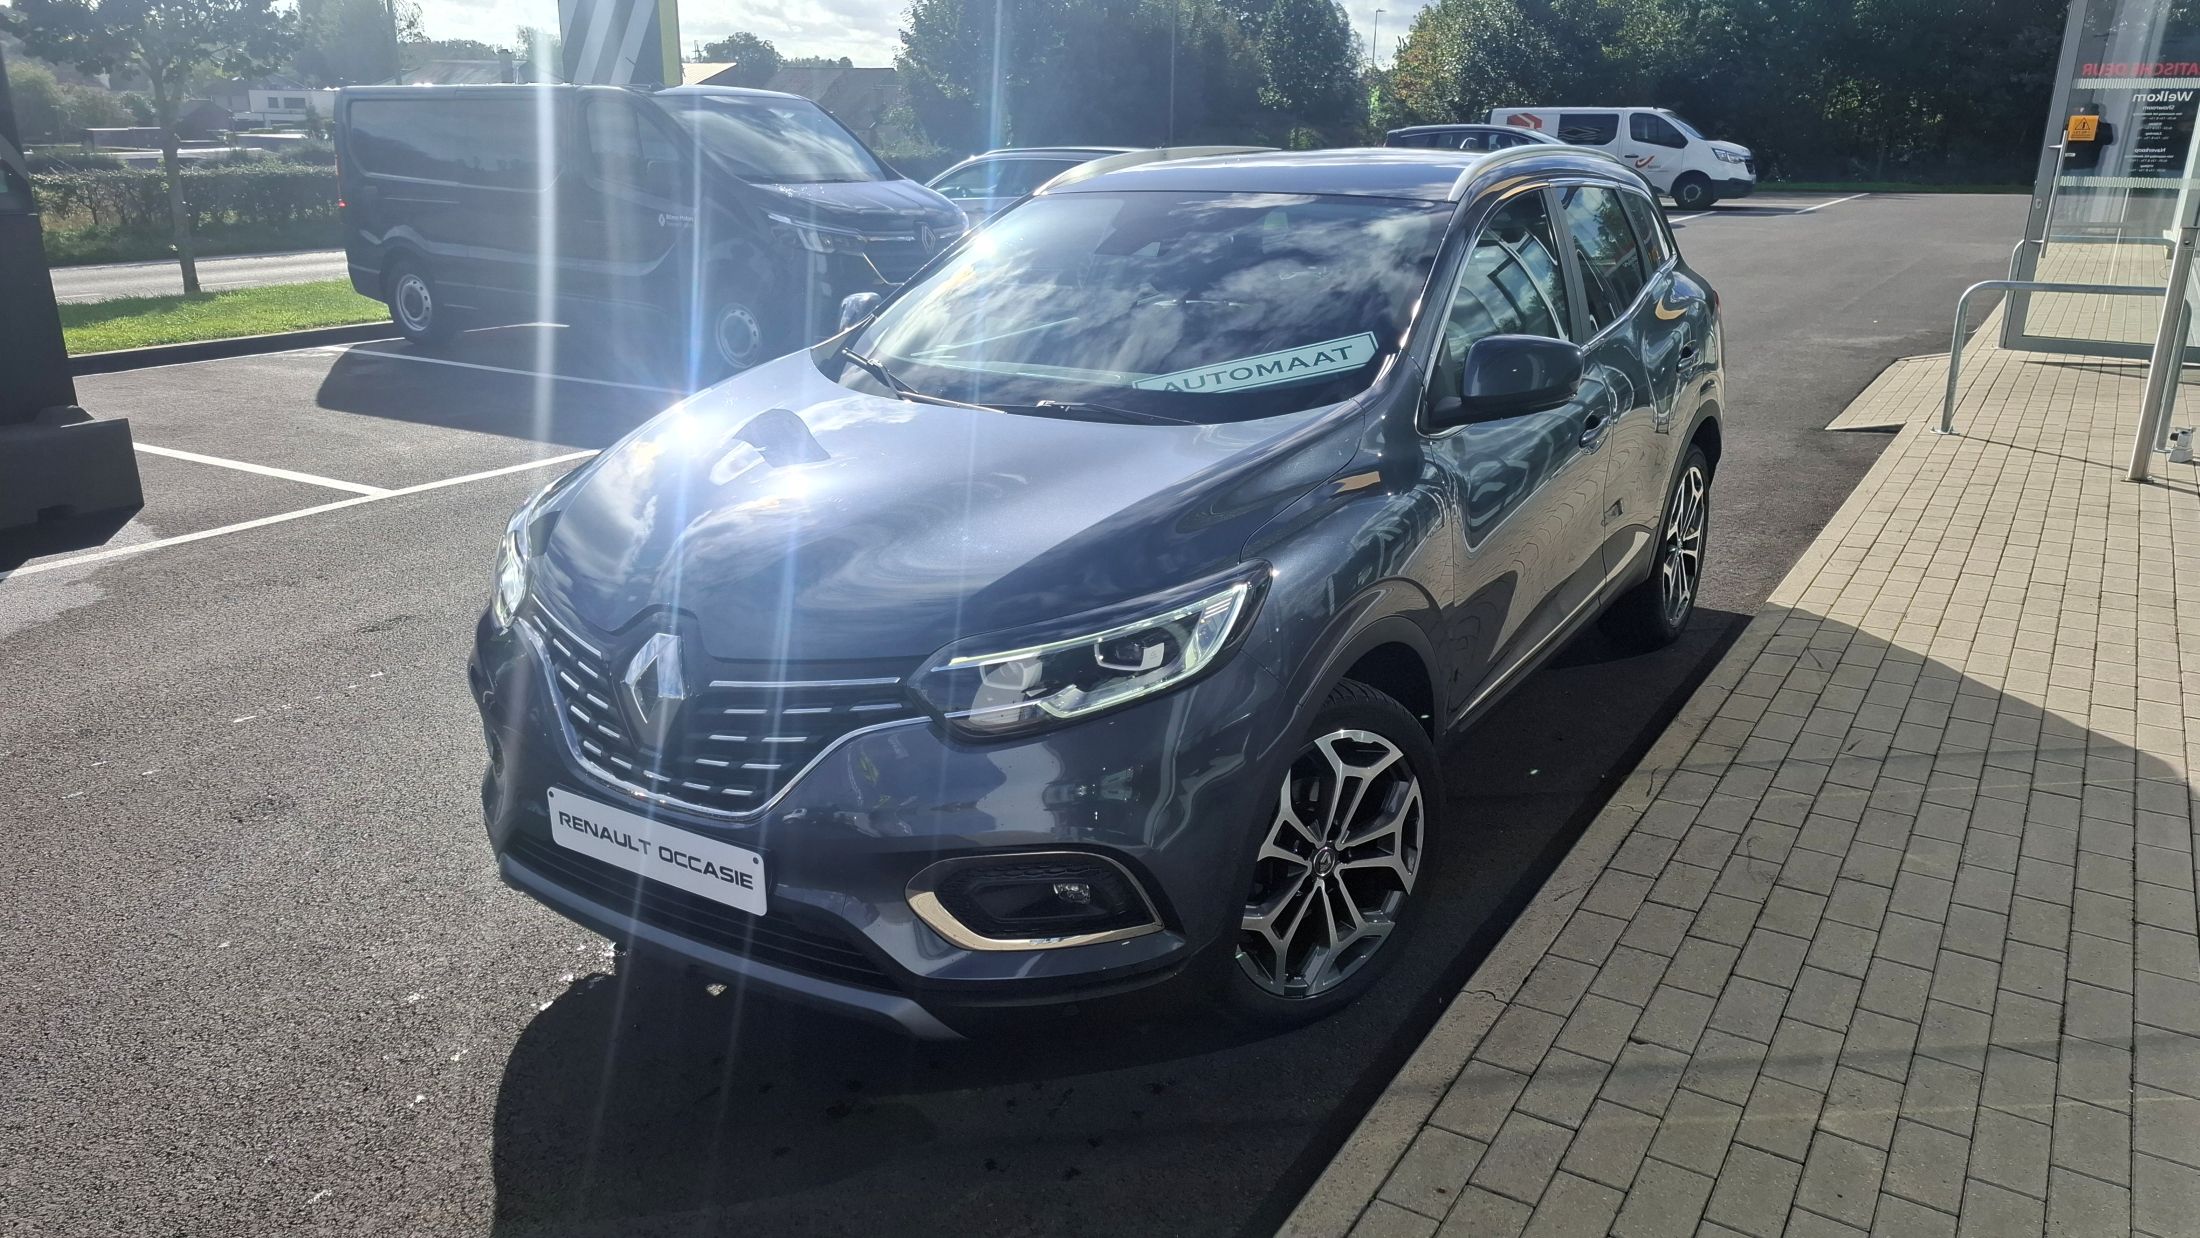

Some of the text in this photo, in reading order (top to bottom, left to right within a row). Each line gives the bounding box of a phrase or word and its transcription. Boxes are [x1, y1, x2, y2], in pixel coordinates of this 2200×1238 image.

[1164, 346, 1352, 392] AUTOMAAT
[558, 811, 753, 889] RENAULT OCCASIE
